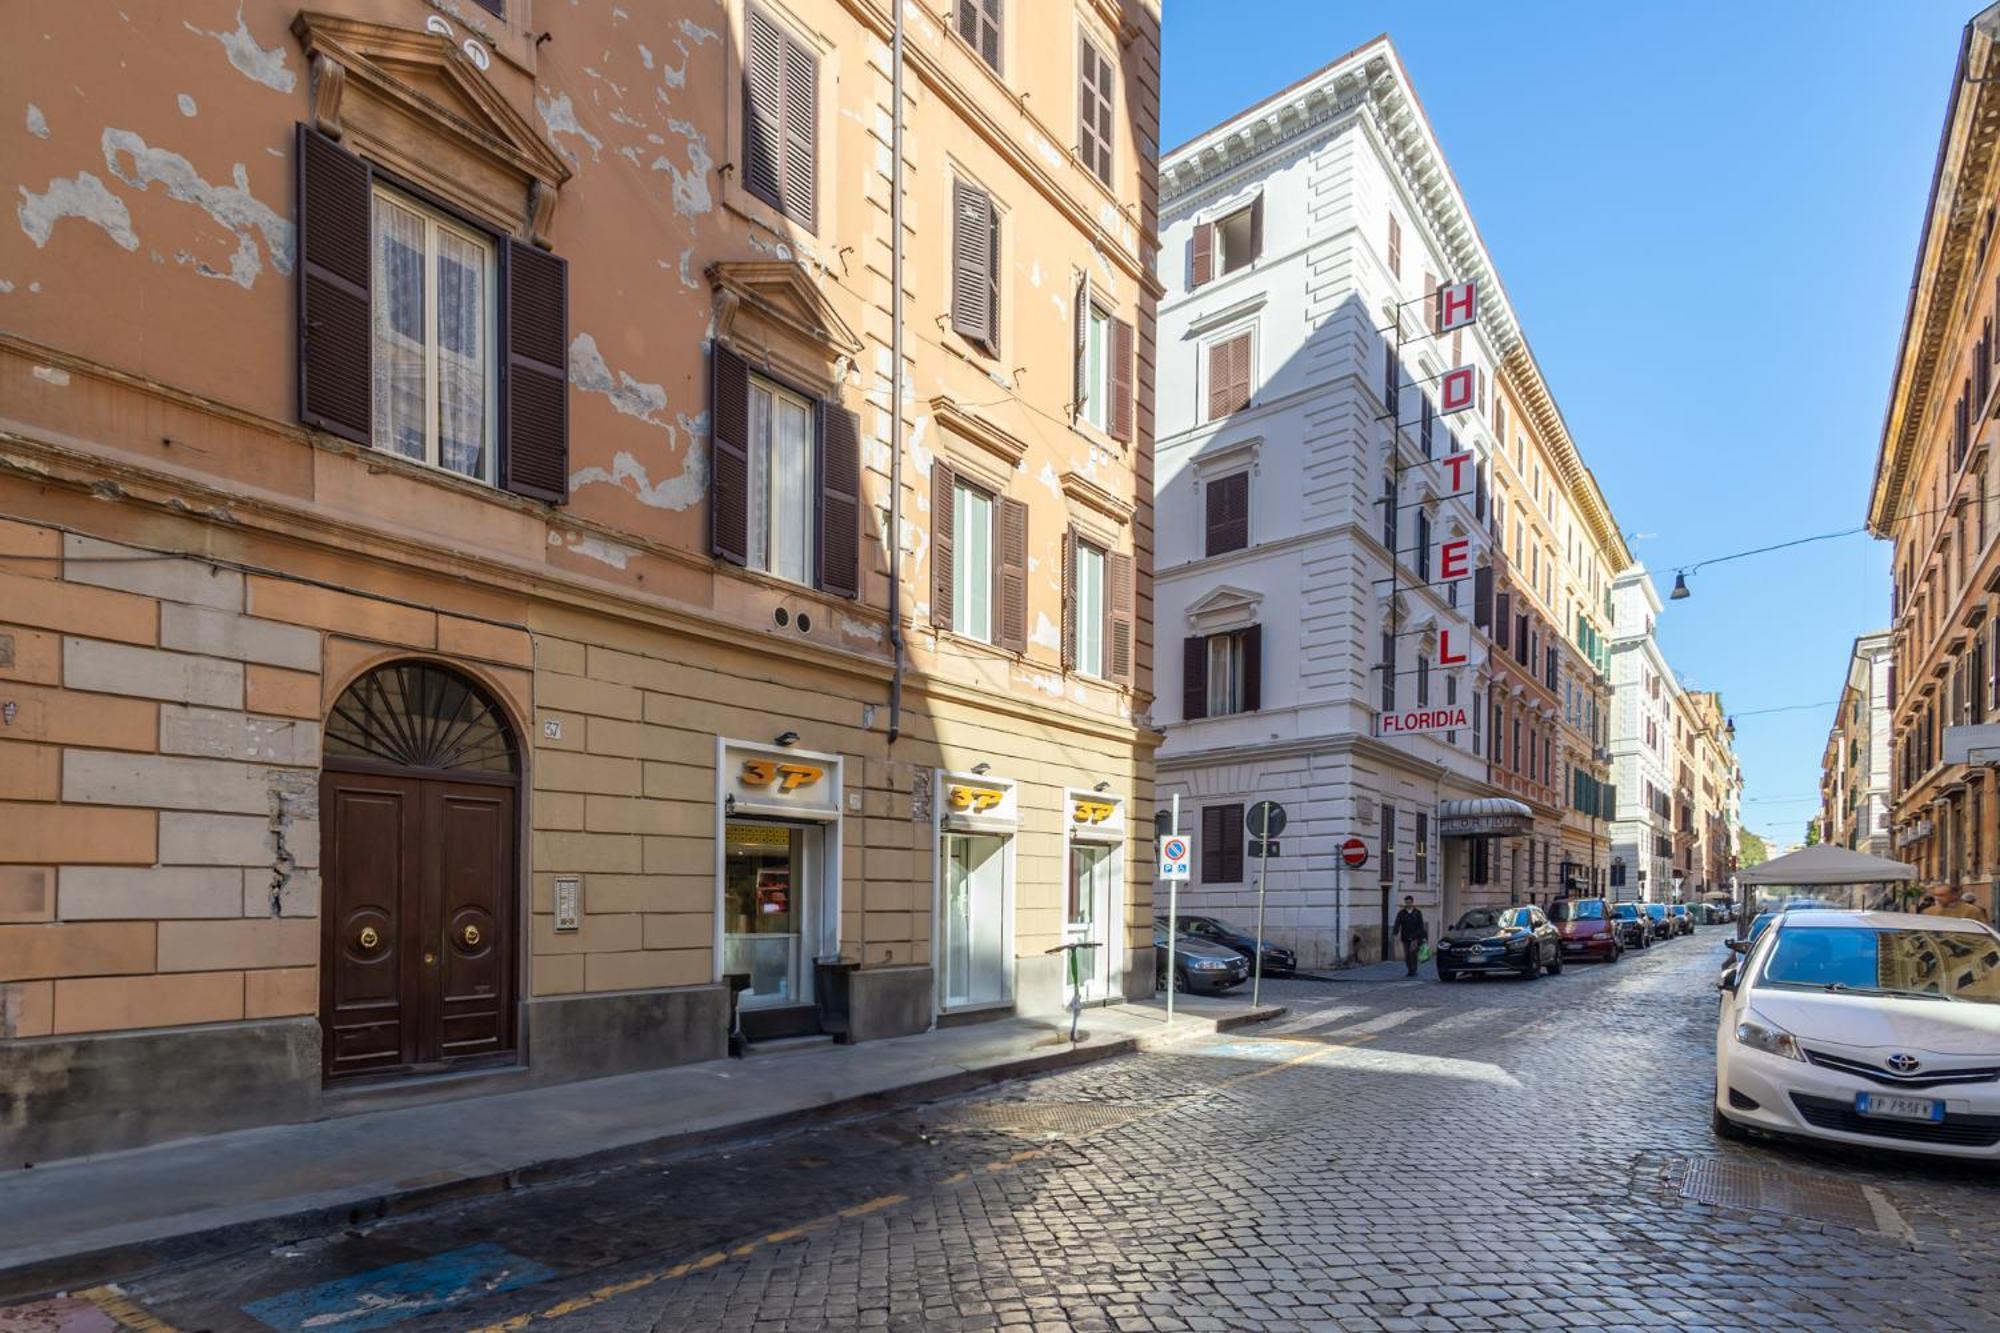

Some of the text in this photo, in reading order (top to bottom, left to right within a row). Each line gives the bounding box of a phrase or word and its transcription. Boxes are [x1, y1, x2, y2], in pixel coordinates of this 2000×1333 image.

[1440, 282, 1475, 665] HOTEL
[545, 721, 559, 737] 37
[1383, 708, 1467, 732] FLORIDIA
